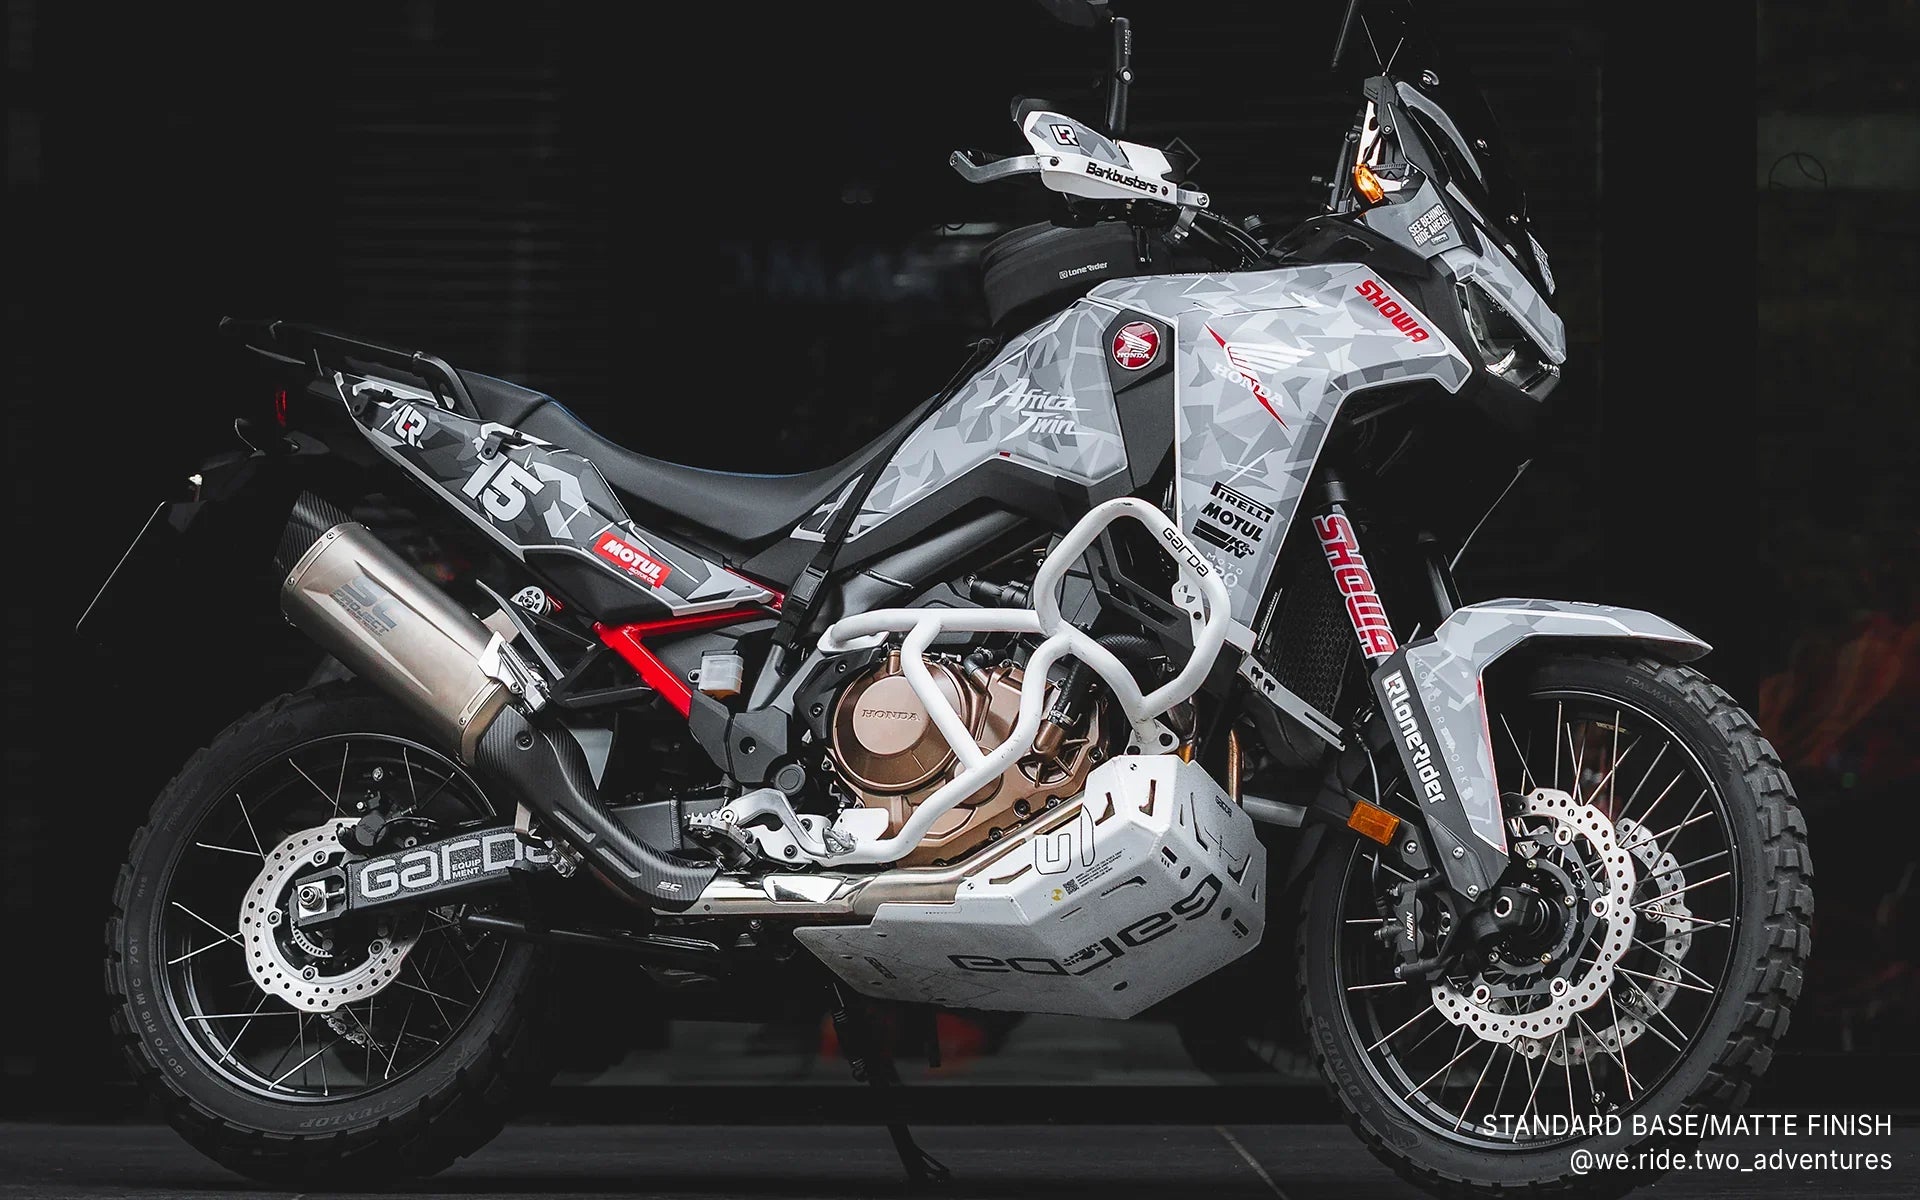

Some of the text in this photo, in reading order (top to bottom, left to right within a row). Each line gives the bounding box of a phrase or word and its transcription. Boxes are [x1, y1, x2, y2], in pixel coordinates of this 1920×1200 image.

[1086, 161, 1158, 194] Barkbusters
[1408, 220, 1423, 236] SEE
[1414, 228, 1431, 246] RIDE
[1354, 279, 1430, 343] SHOWA
[1116, 351, 1151, 361] HONDA
[975, 378, 1092, 413] Africa
[1211, 362, 1285, 408] HONDA
[999, 410, 1098, 442] Twin
[461, 451, 545, 521] 15
[1210, 481, 1274, 523] PIRELLI
[1201, 502, 1263, 542] MOTUL
[602, 539, 662, 580] MOTUL
[1312, 513, 1399, 660] SHOWA
[862, 709, 920, 722] HONDA
[452, 859, 481, 871] EQUIP
[452, 867, 480, 880] MENT
[300, 1103, 387, 1128] DUNLOP
